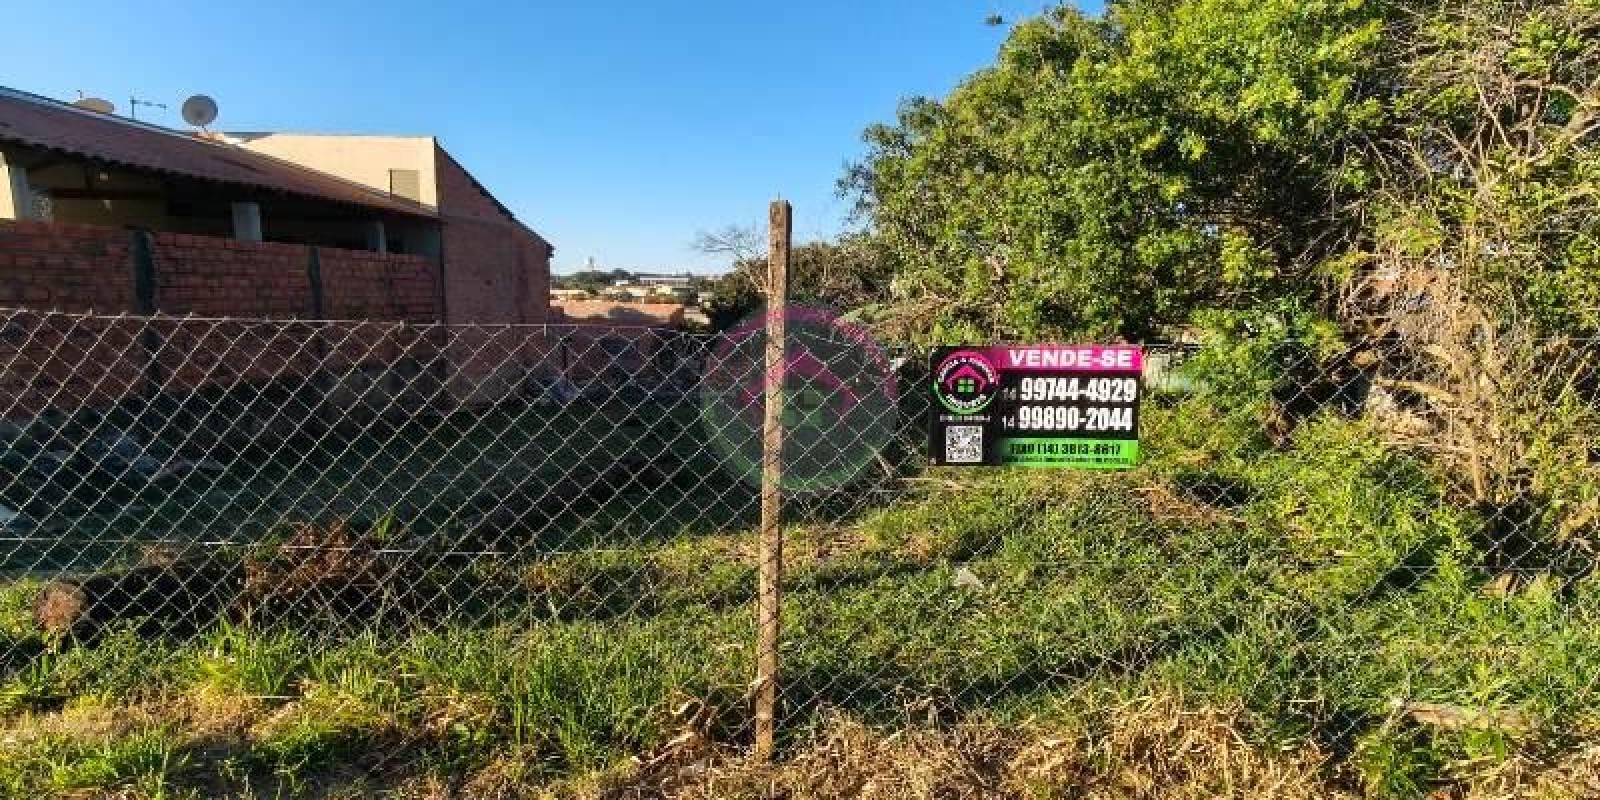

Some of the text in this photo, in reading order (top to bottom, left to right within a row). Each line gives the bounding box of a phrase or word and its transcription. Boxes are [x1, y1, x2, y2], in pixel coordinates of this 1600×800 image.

[1009, 349, 1133, 367] VENDE-SE
[1021, 377, 1137, 402] 99744-4929
[1002, 415, 1015, 430] 14
[1019, 406, 1133, 431] 99890-2044
